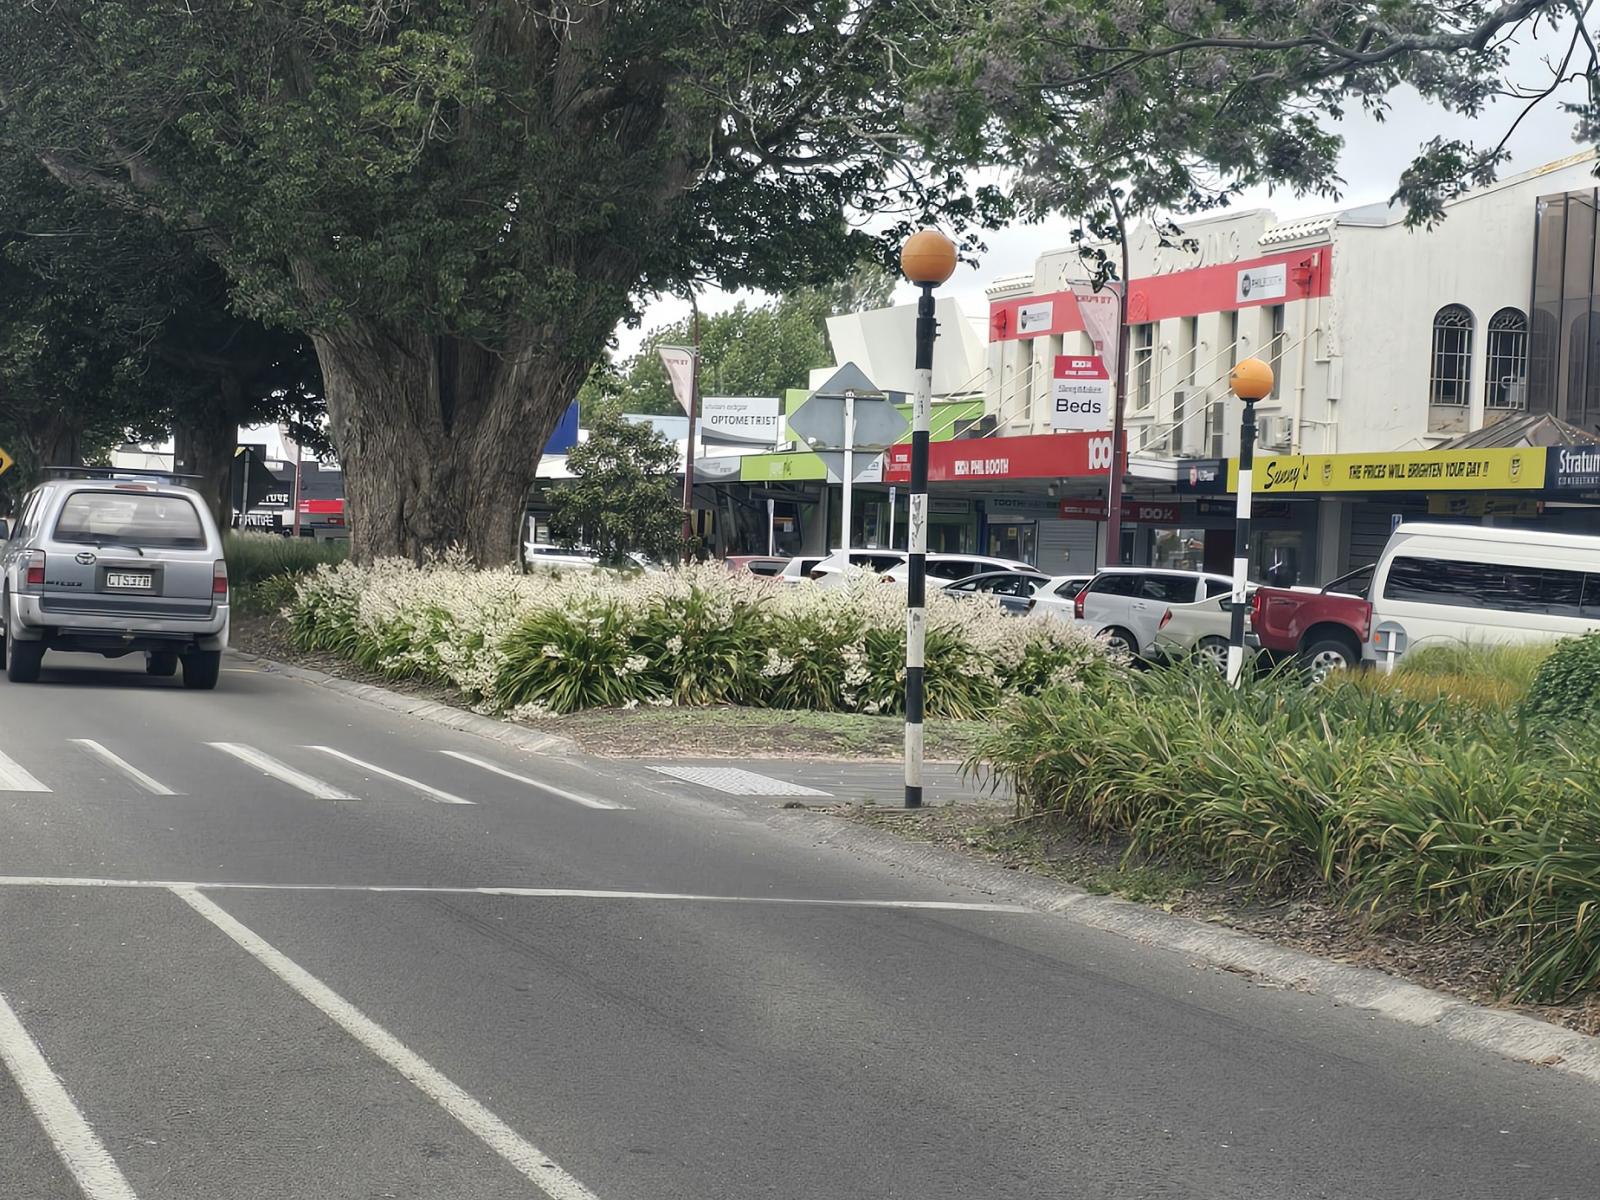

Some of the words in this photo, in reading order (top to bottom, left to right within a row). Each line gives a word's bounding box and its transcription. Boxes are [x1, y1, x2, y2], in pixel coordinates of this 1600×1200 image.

[1056, 398, 1102, 414] Beds
[711, 415, 777, 425] OPTOMETRIST
[970, 460, 984, 475] PHIL
[985, 459, 1009, 474] BOOTH
[1264, 456, 1309, 491] Sunny's
[1349, 465, 1362, 479] THE
[1363, 464, 1386, 479] PRICES
[1388, 464, 1405, 479] WILL
[1407, 463, 1443, 478] BRIGHTEN
[1445, 462, 1465, 477] YOUR
[1466, 462, 1481, 477] DAY
